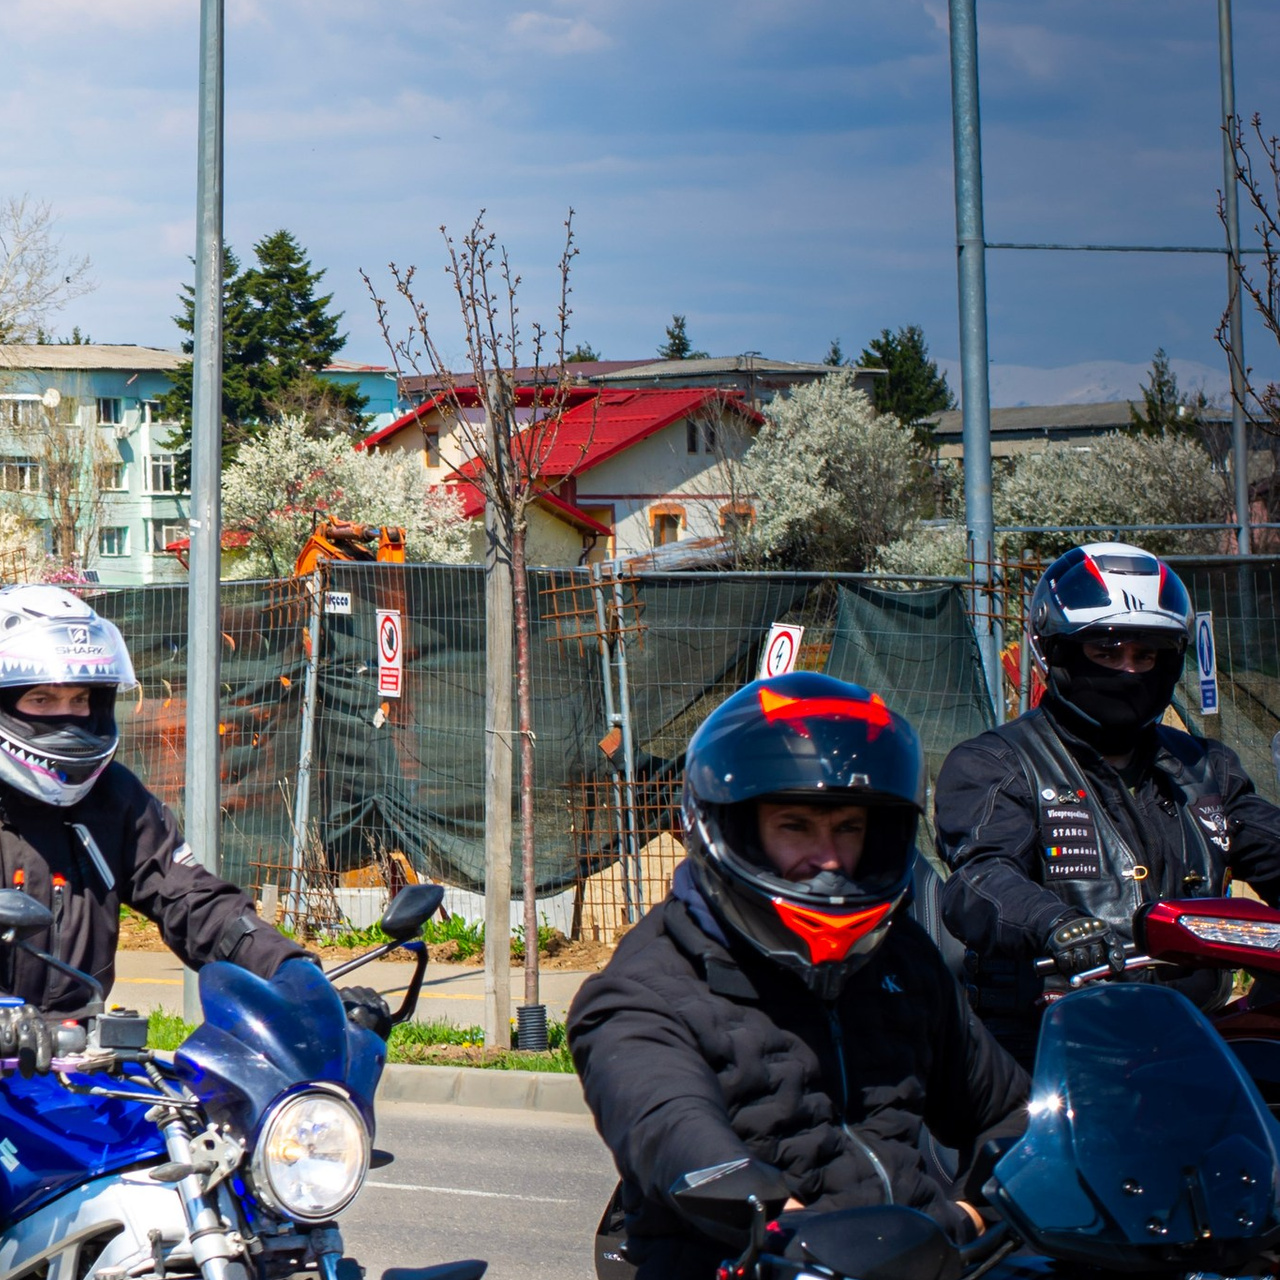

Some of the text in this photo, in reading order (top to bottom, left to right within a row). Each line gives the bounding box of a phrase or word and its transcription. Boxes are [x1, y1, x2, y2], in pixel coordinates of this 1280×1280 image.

[55, 646, 105, 656] SHARK
[1052, 828, 1088, 838] STANCU
[1062, 846, 1097, 855] România
